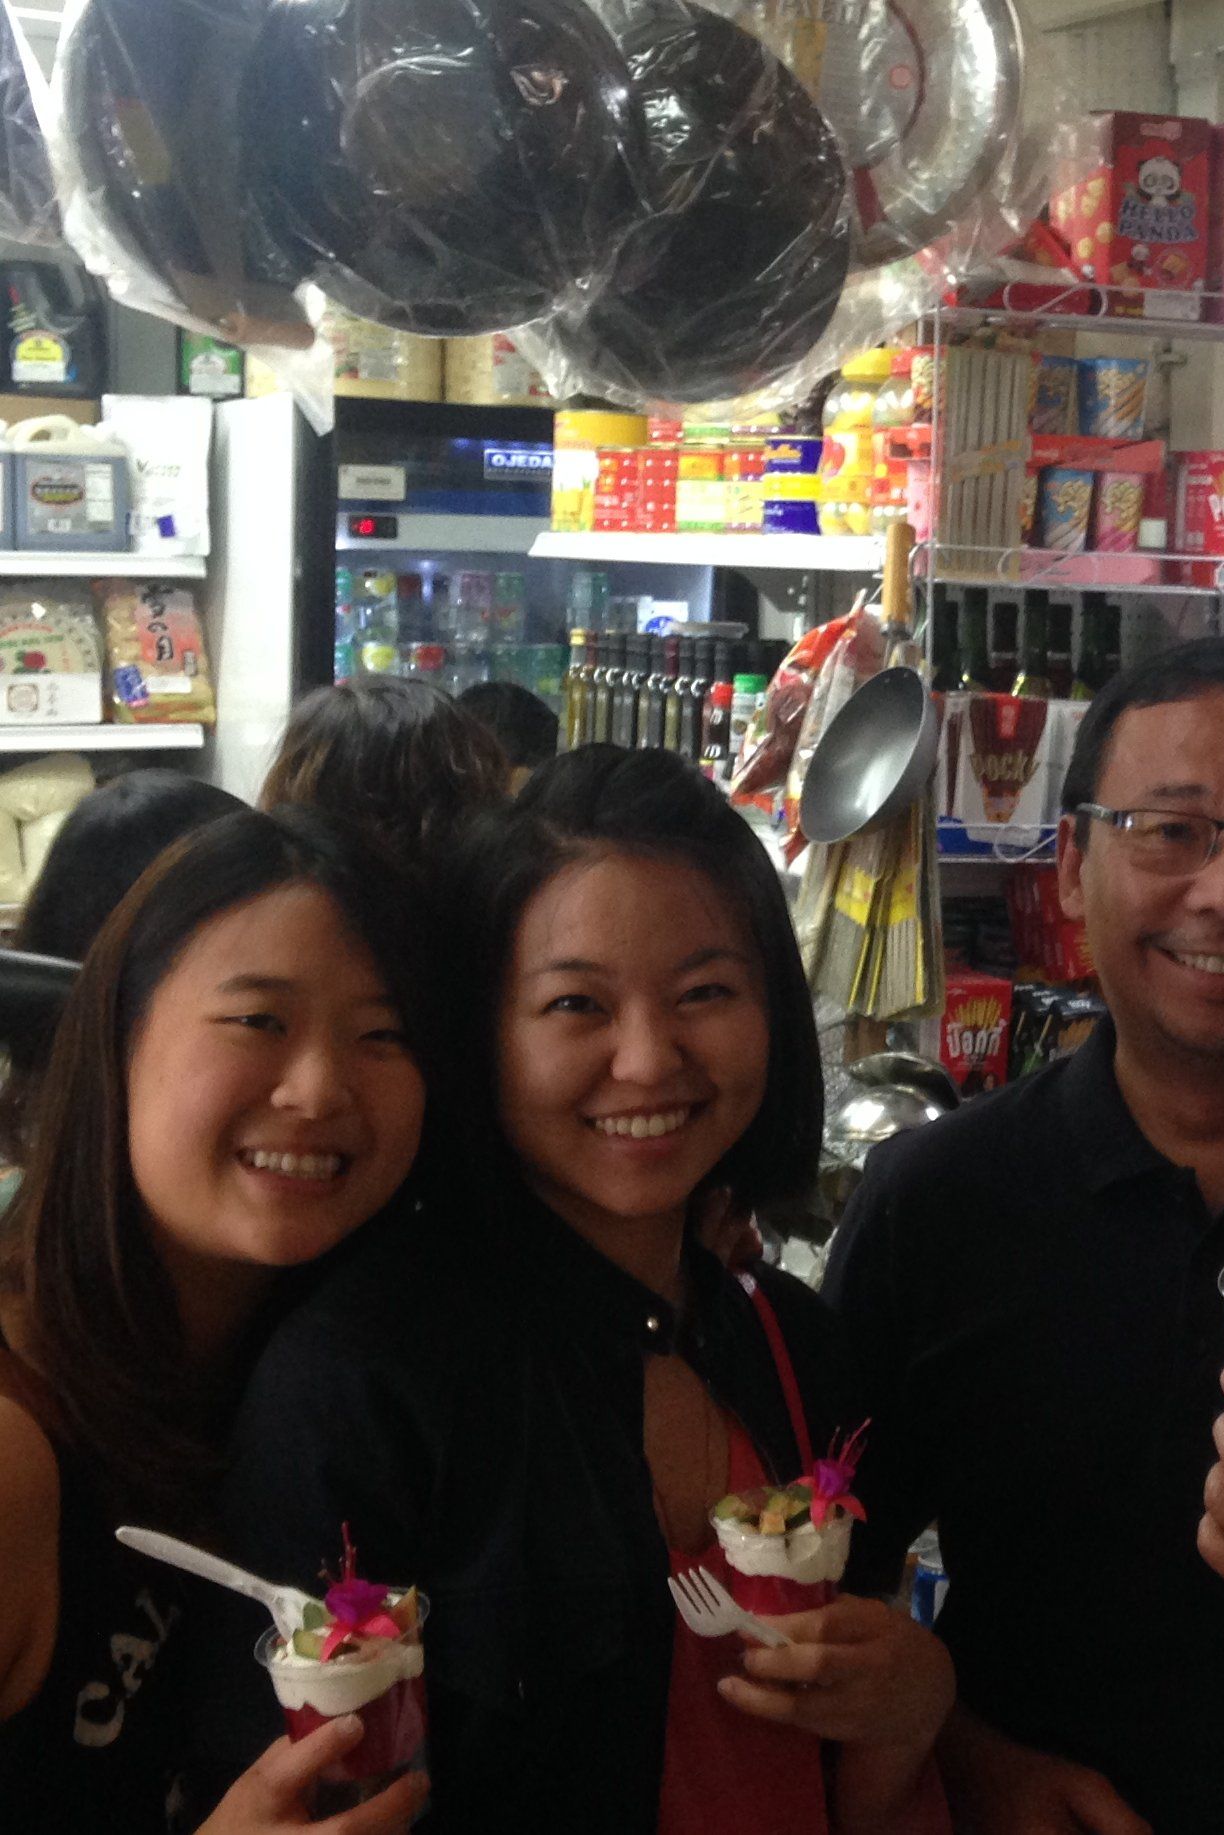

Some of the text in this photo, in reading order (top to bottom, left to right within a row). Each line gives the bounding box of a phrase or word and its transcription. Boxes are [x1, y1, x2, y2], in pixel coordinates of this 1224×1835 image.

[1121, 200, 1194, 220] HELLO
[1118, 220, 1198, 239] PANDA
[490, 453, 552, 469] OJEDA
